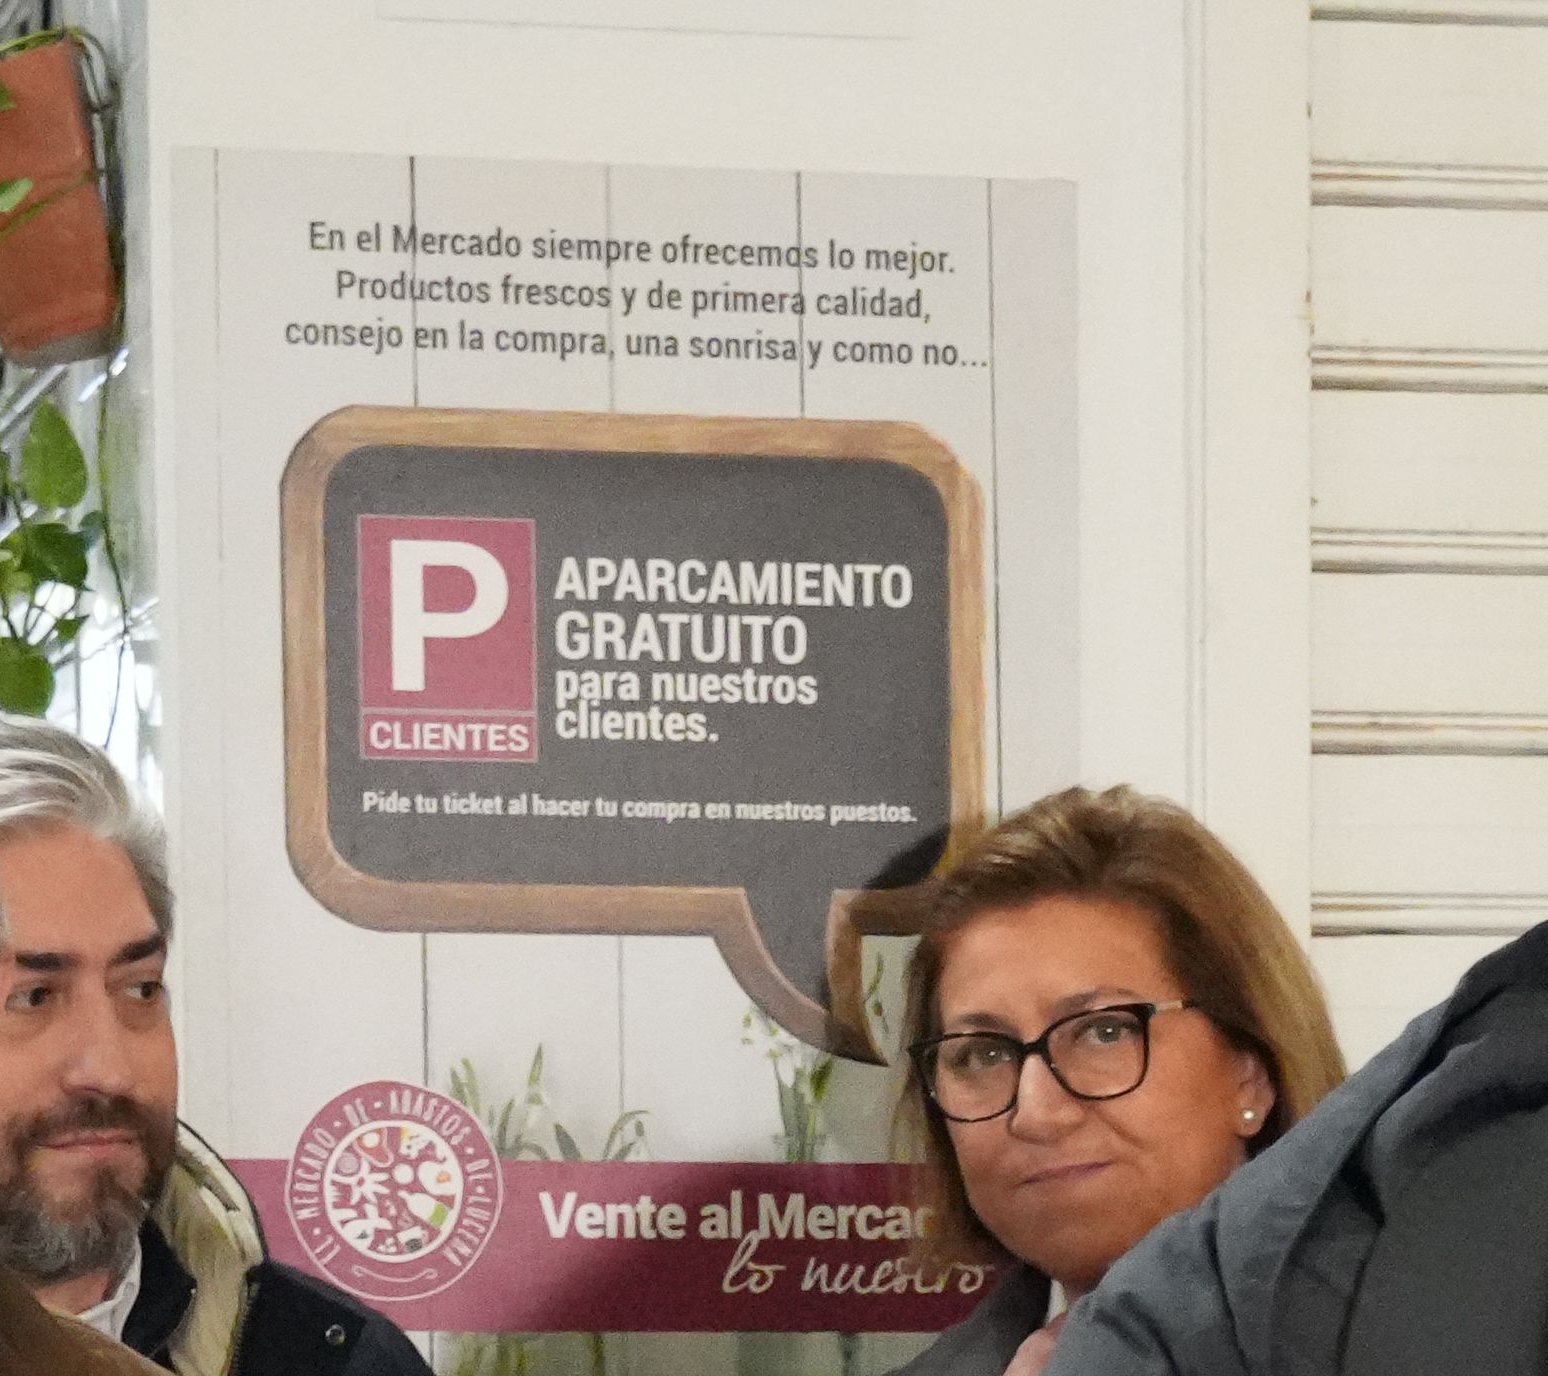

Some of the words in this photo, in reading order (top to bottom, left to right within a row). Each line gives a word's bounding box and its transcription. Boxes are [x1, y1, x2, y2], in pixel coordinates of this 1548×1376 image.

[309, 221, 345, 250] En
[357, 222, 381, 252] el
[393, 224, 521, 257] Mercado
[532, 229, 651, 268] siempre
[661, 234, 819, 268] ofrecemos
[828, 239, 855, 270] lo
[865, 242, 955, 279] mejor.
[336, 270, 491, 303] Productos
[502, 274, 612, 307] frescos
[620, 286, 636, 316] y
[647, 281, 682, 310] de
[692, 282, 805, 318] primera
[816, 287, 931, 323] calidad,
[285, 317, 404, 355] consejo
[414, 324, 449, 350] en
[458, 320, 484, 351] la
[495, 328, 615, 361] compra,
[626, 334, 680, 358] una
[689, 330, 796, 361] sonrisa
[807, 339, 822, 369] y
[832, 340, 913, 365] como
[923, 343, 988, 367] no...
[553, 556, 913, 608] APARCAMIENTO
[390, 539, 509, 692] P
[554, 610, 808, 665] GRATUITO
[555, 668, 640, 707] para
[653, 669, 818, 705] nuestros
[369, 720, 530, 752] CLIENTES
[555, 700, 719, 742] clientes.
[362, 790, 412, 814] Pide
[414, 793, 438, 815] tu
[443, 791, 504, 816] ticket
[508, 792, 528, 816] al
[531, 793, 590, 818] hacer
[595, 796, 619, 818] tu
[622, 801, 701, 824] compra
[704, 802, 731, 820] en
[734, 800, 826, 822] nuestros
[829, 801, 918, 827] puestos.
[292, 1127, 337, 1220] MERCADO
[389, 1088, 472, 1147] ABASTOS
[442, 1195, 493, 1267] LUCENA
[538, 1190, 688, 1240] Vente
[698, 1188, 743, 1240] al
[722, 1228, 786, 1295] lo
